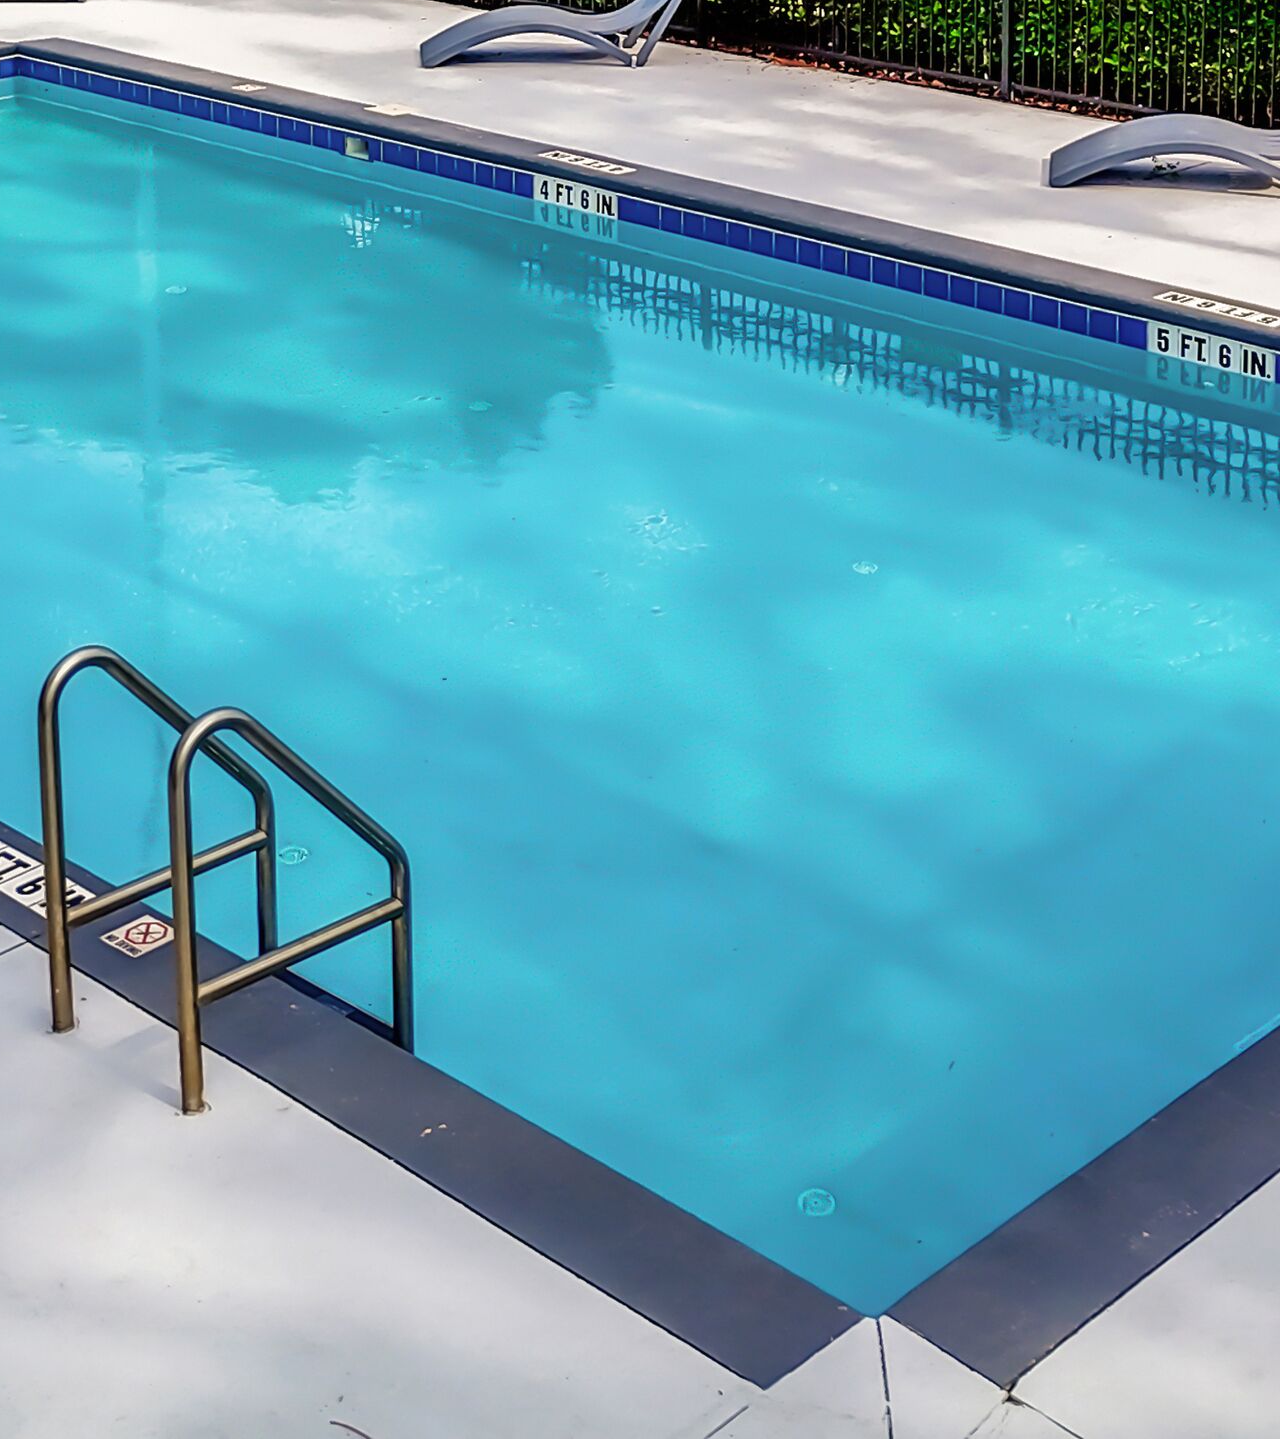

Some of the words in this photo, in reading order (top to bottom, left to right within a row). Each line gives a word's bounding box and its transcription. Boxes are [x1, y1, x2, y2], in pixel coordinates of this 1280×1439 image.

[540, 180, 549, 200] 4
[581, 189, 589, 210] 6
[1157, 327, 1170, 352] 5
[1218, 344, 1232, 368] 6
[1242, 349, 1272, 379] IN.
